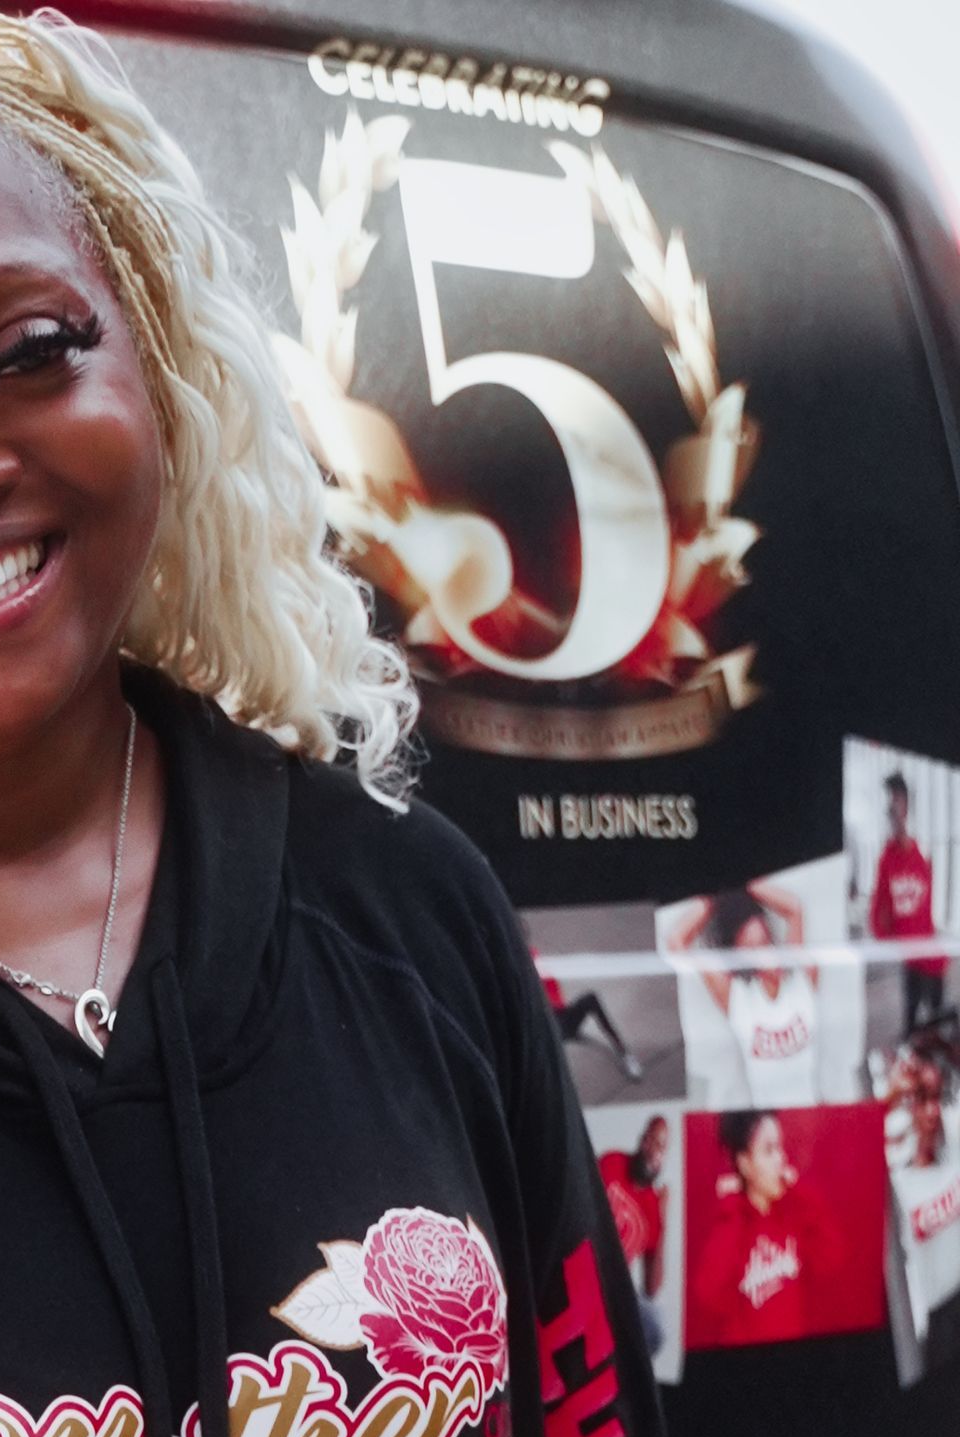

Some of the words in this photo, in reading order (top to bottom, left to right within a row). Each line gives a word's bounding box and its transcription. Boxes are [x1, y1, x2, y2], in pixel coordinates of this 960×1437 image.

[305, 38, 611, 137] CELEBRATING
[397, 142, 671, 681] 5
[518, 794, 556, 840] IN
[559, 794, 699, 840] BUSINESS
